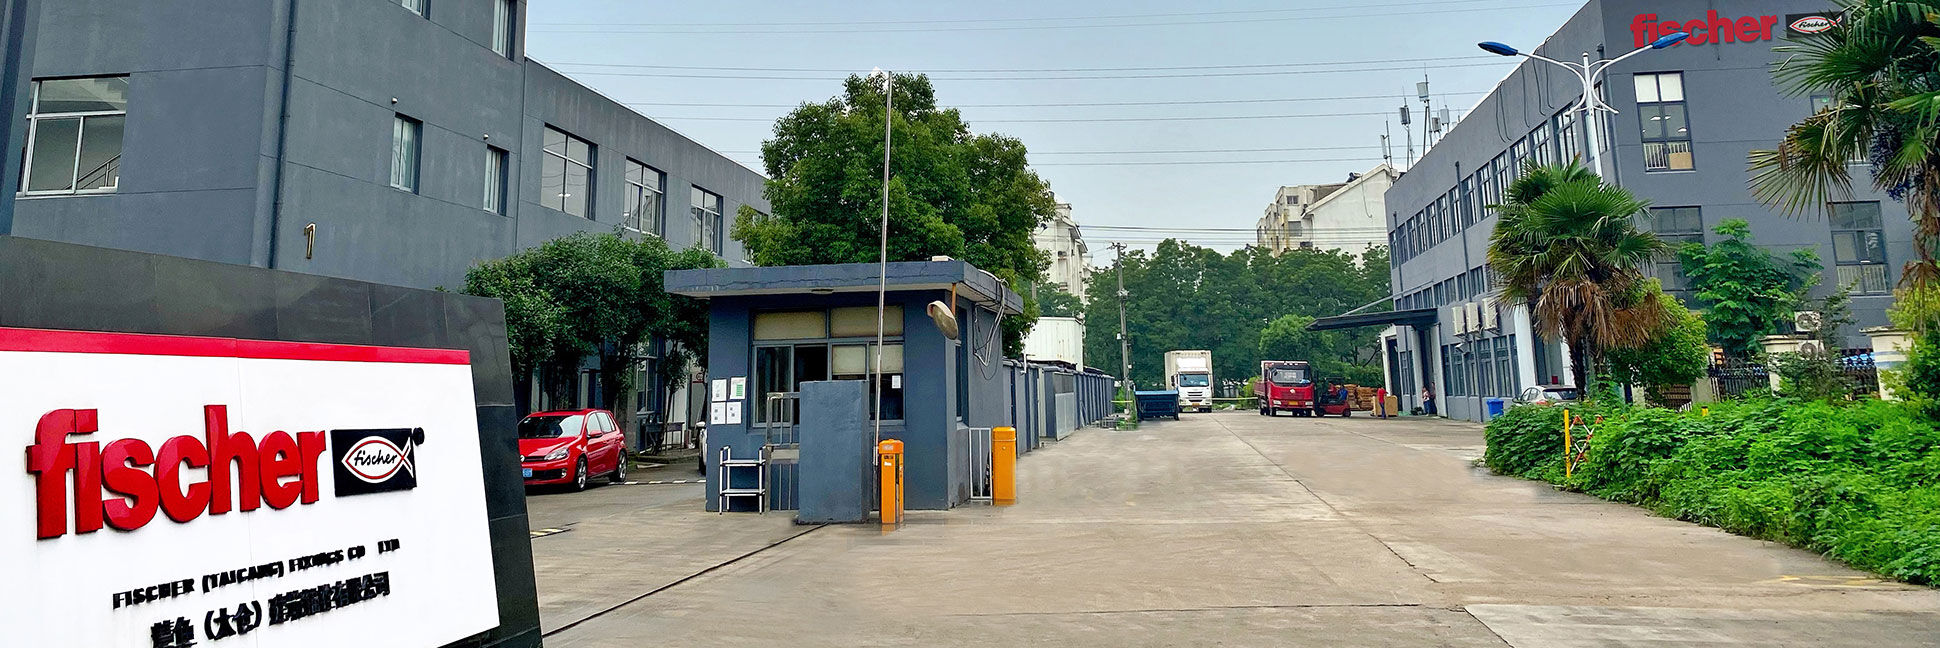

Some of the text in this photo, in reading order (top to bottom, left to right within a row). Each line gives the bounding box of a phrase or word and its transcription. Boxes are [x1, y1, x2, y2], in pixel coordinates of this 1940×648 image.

[1630, 9, 1777, 48] fischer
[304, 222, 316, 259] 1
[27, 404, 326, 539] fischer
[354, 449, 398, 466] fischer
[113, 578, 194, 610] FISCHER
[202, 561, 285, 594] (TAICANG)
[289, 550, 344, 572] FIXINGS
